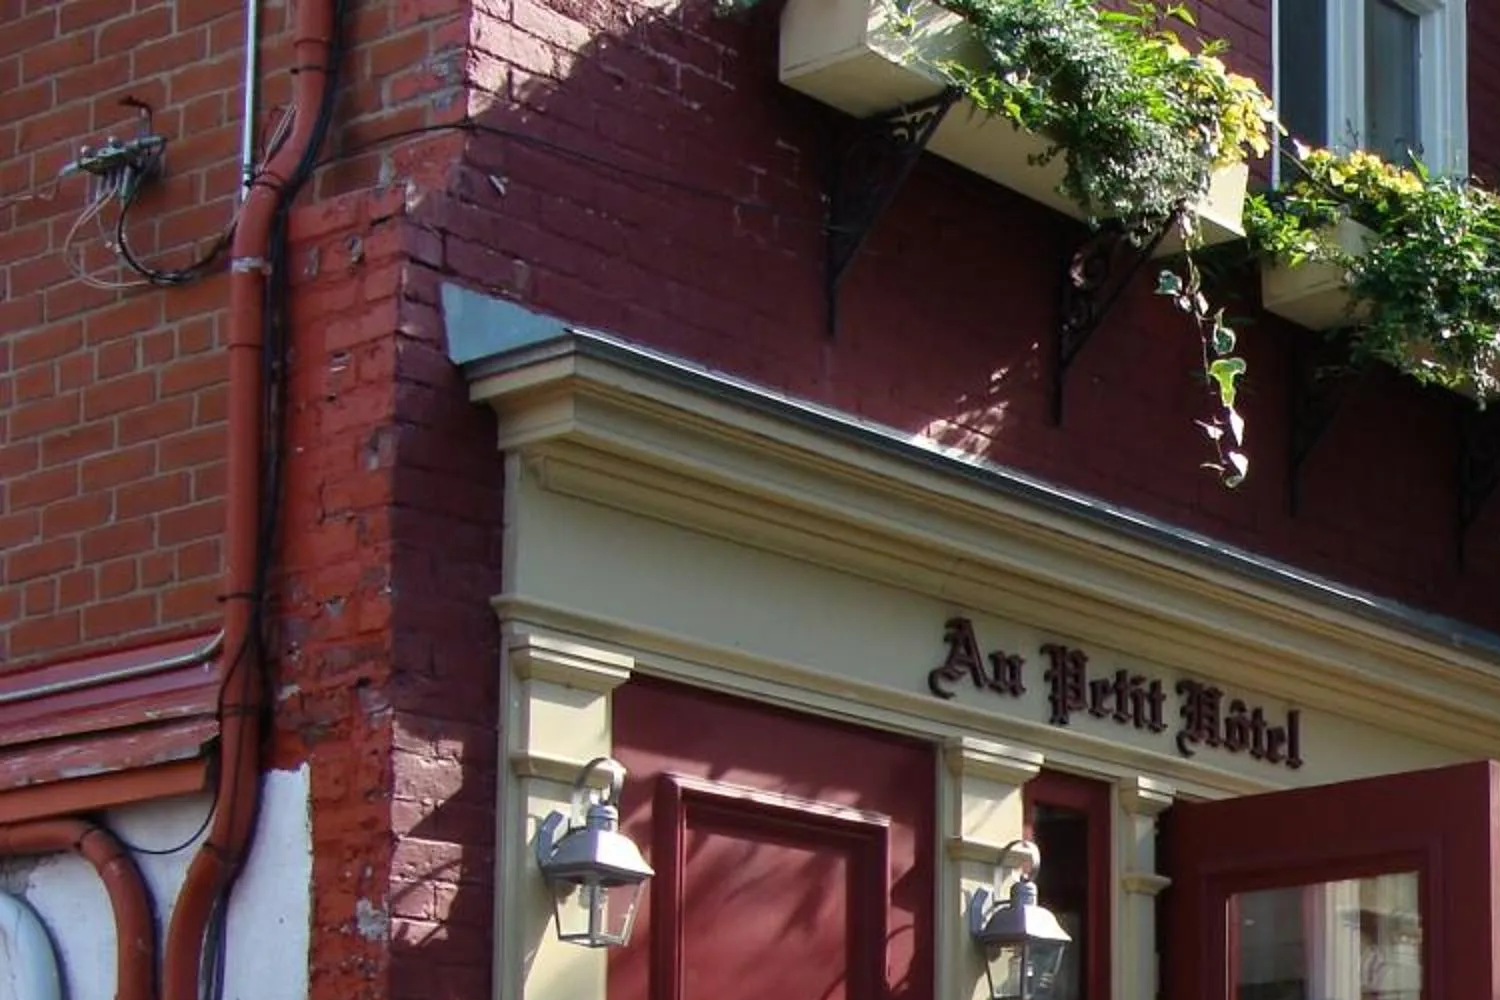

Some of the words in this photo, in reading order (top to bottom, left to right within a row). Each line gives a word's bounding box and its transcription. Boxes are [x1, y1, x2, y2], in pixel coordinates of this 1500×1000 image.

[928, 617, 1026, 699] Au
[1040, 643, 1168, 733] Petit
[1175, 678, 1303, 770] Hôtel
